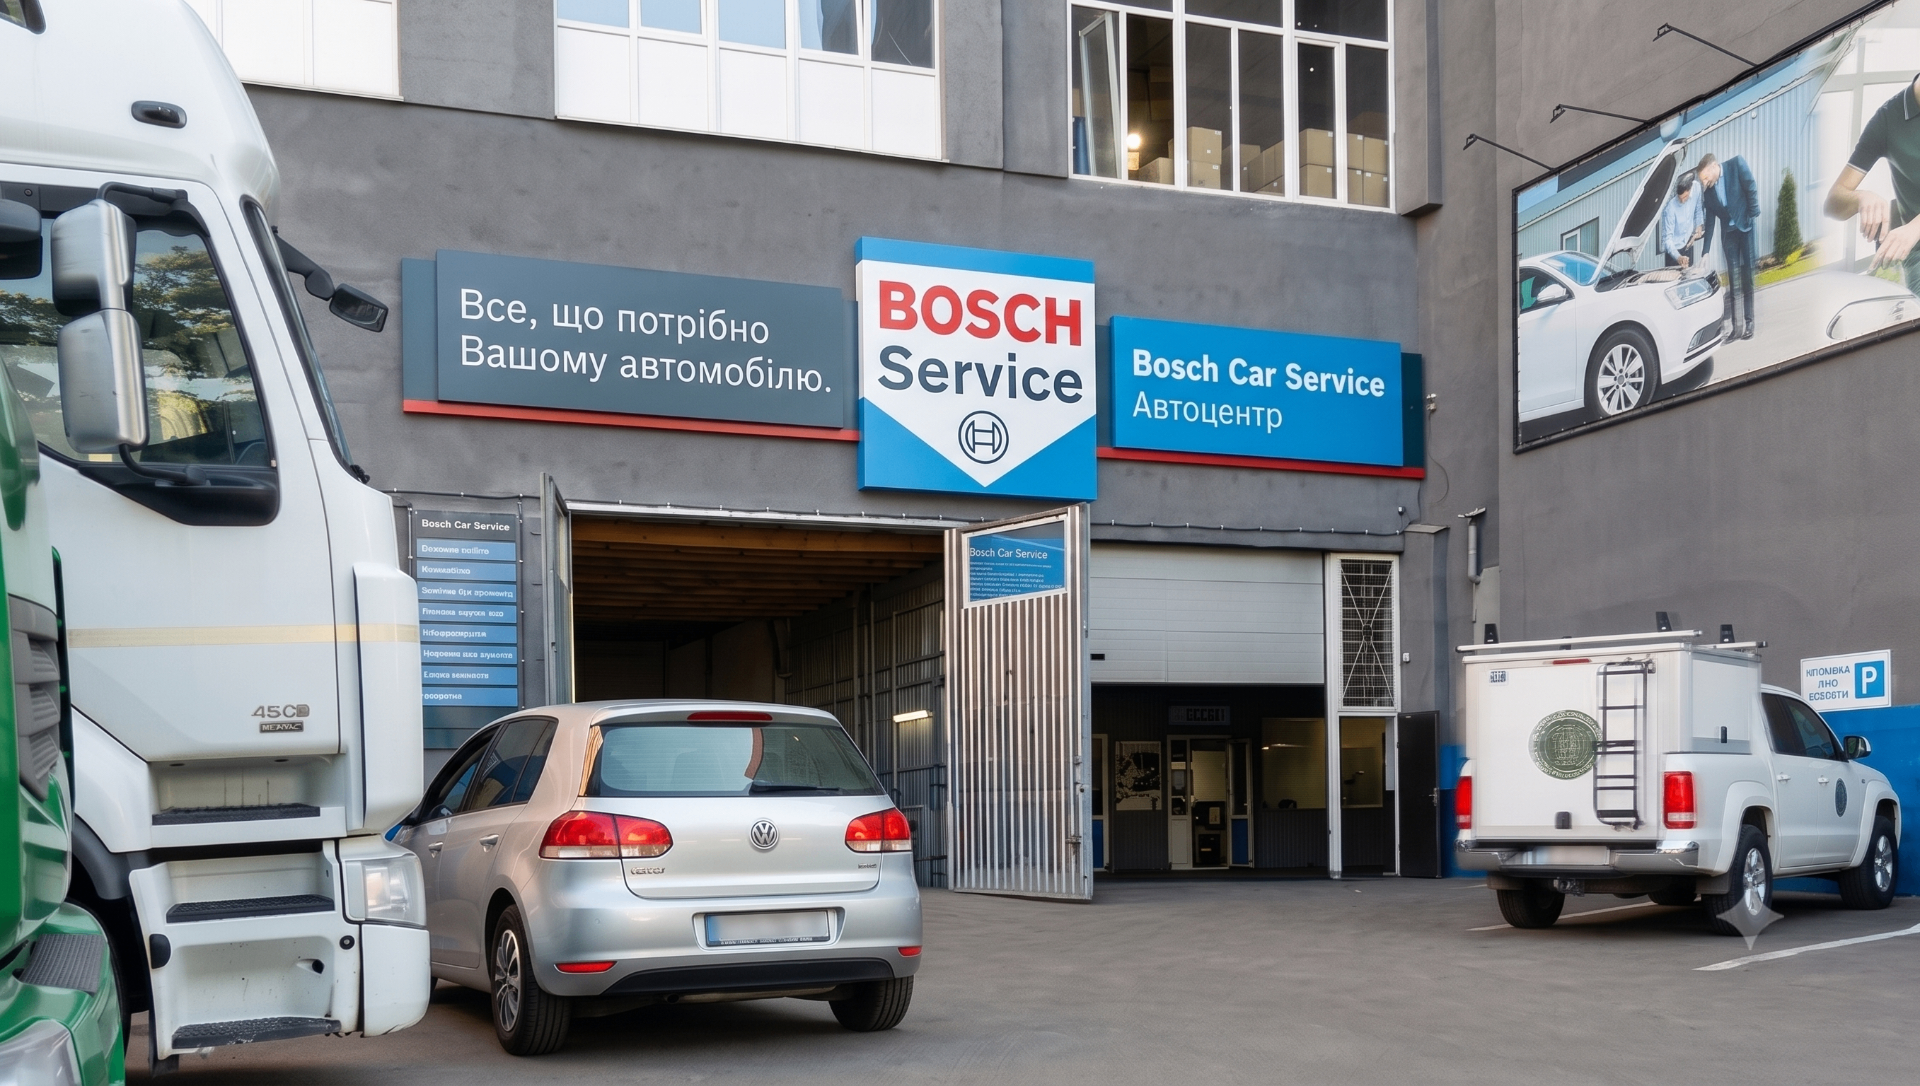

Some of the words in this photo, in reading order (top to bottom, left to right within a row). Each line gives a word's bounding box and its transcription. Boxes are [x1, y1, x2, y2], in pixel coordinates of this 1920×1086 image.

[460, 287, 538, 330] Все,
[552, 302, 605, 334] що
[617, 308, 770, 345] потрібно
[878, 279, 1082, 346] BOSCH
[460, 333, 608, 383] Вашому
[619, 353, 832, 393] автомобілю.
[877, 344, 1084, 404] Service
[1132, 348, 1220, 382] Bosch
[1228, 357, 1277, 388] Car
[1285, 363, 1386, 397] Service
[1131, 392, 1283, 434] Автоцентр
[421, 518, 452, 529] Bosch
[454, 520, 472, 530] Car
[473, 521, 510, 532] Service
[970, 547, 995, 557] Bosch
[997, 548, 1013, 558] Car
[1015, 548, 1048, 559] Service
[1861, 666, 1877, 694] P
